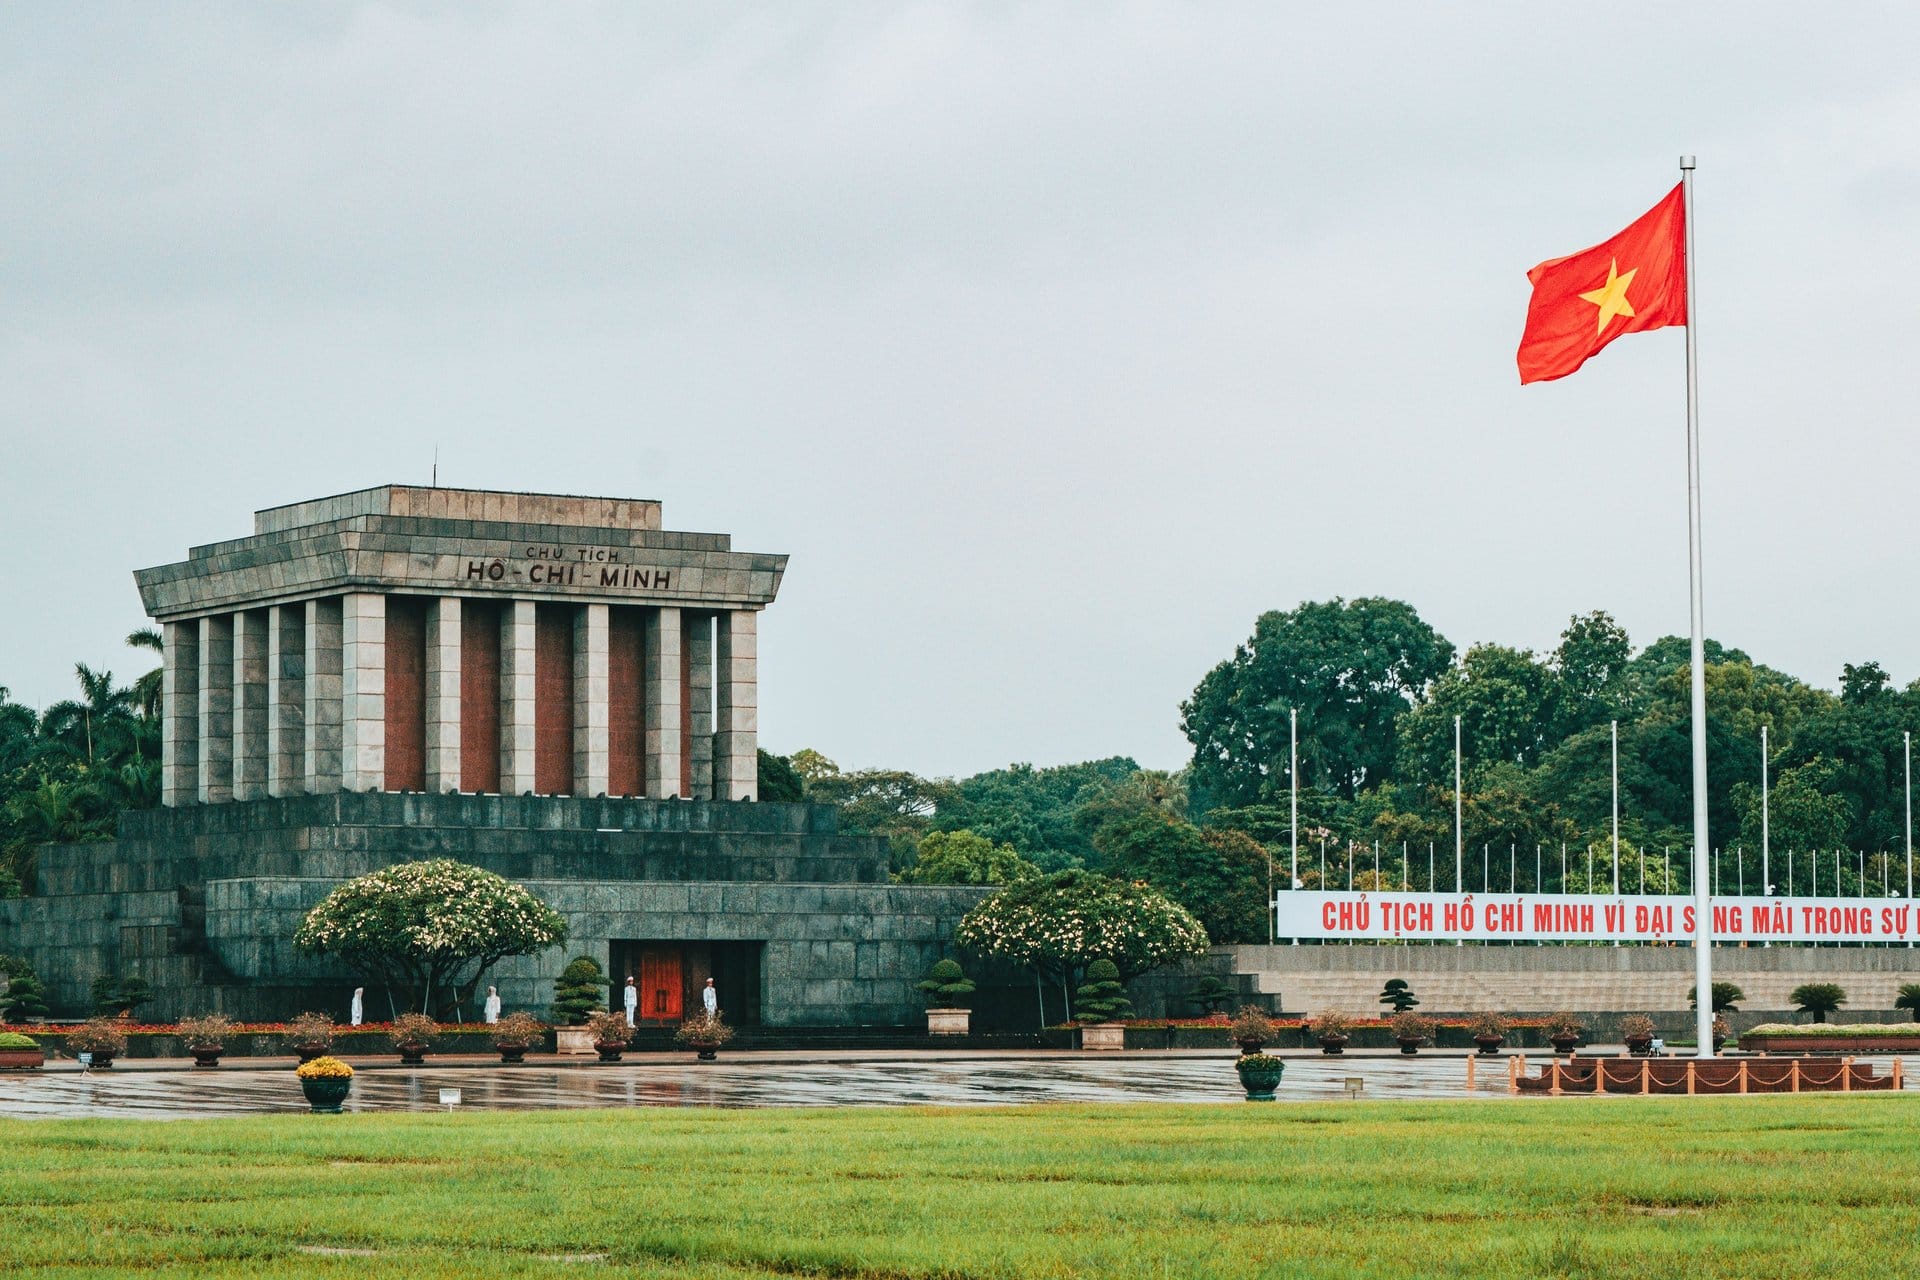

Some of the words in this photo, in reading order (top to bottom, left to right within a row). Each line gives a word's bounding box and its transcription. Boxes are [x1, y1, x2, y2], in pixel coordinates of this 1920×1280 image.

[1322, 894, 1370, 932] CHỦ
[1380, 902, 1434, 937] TỊCH
[1444, 895, 1475, 932] HỒ
[1484, 898, 1524, 933] CHÍ
[1533, 904, 1595, 933] MINH
[1635, 905, 1673, 938] ĐẠI
[1683, 898, 1743, 934] SNG
[1753, 901, 1793, 934] MÃI
[1802, 906, 1873, 935] TRONG
[1881, 904, 1910, 940] SỰ
